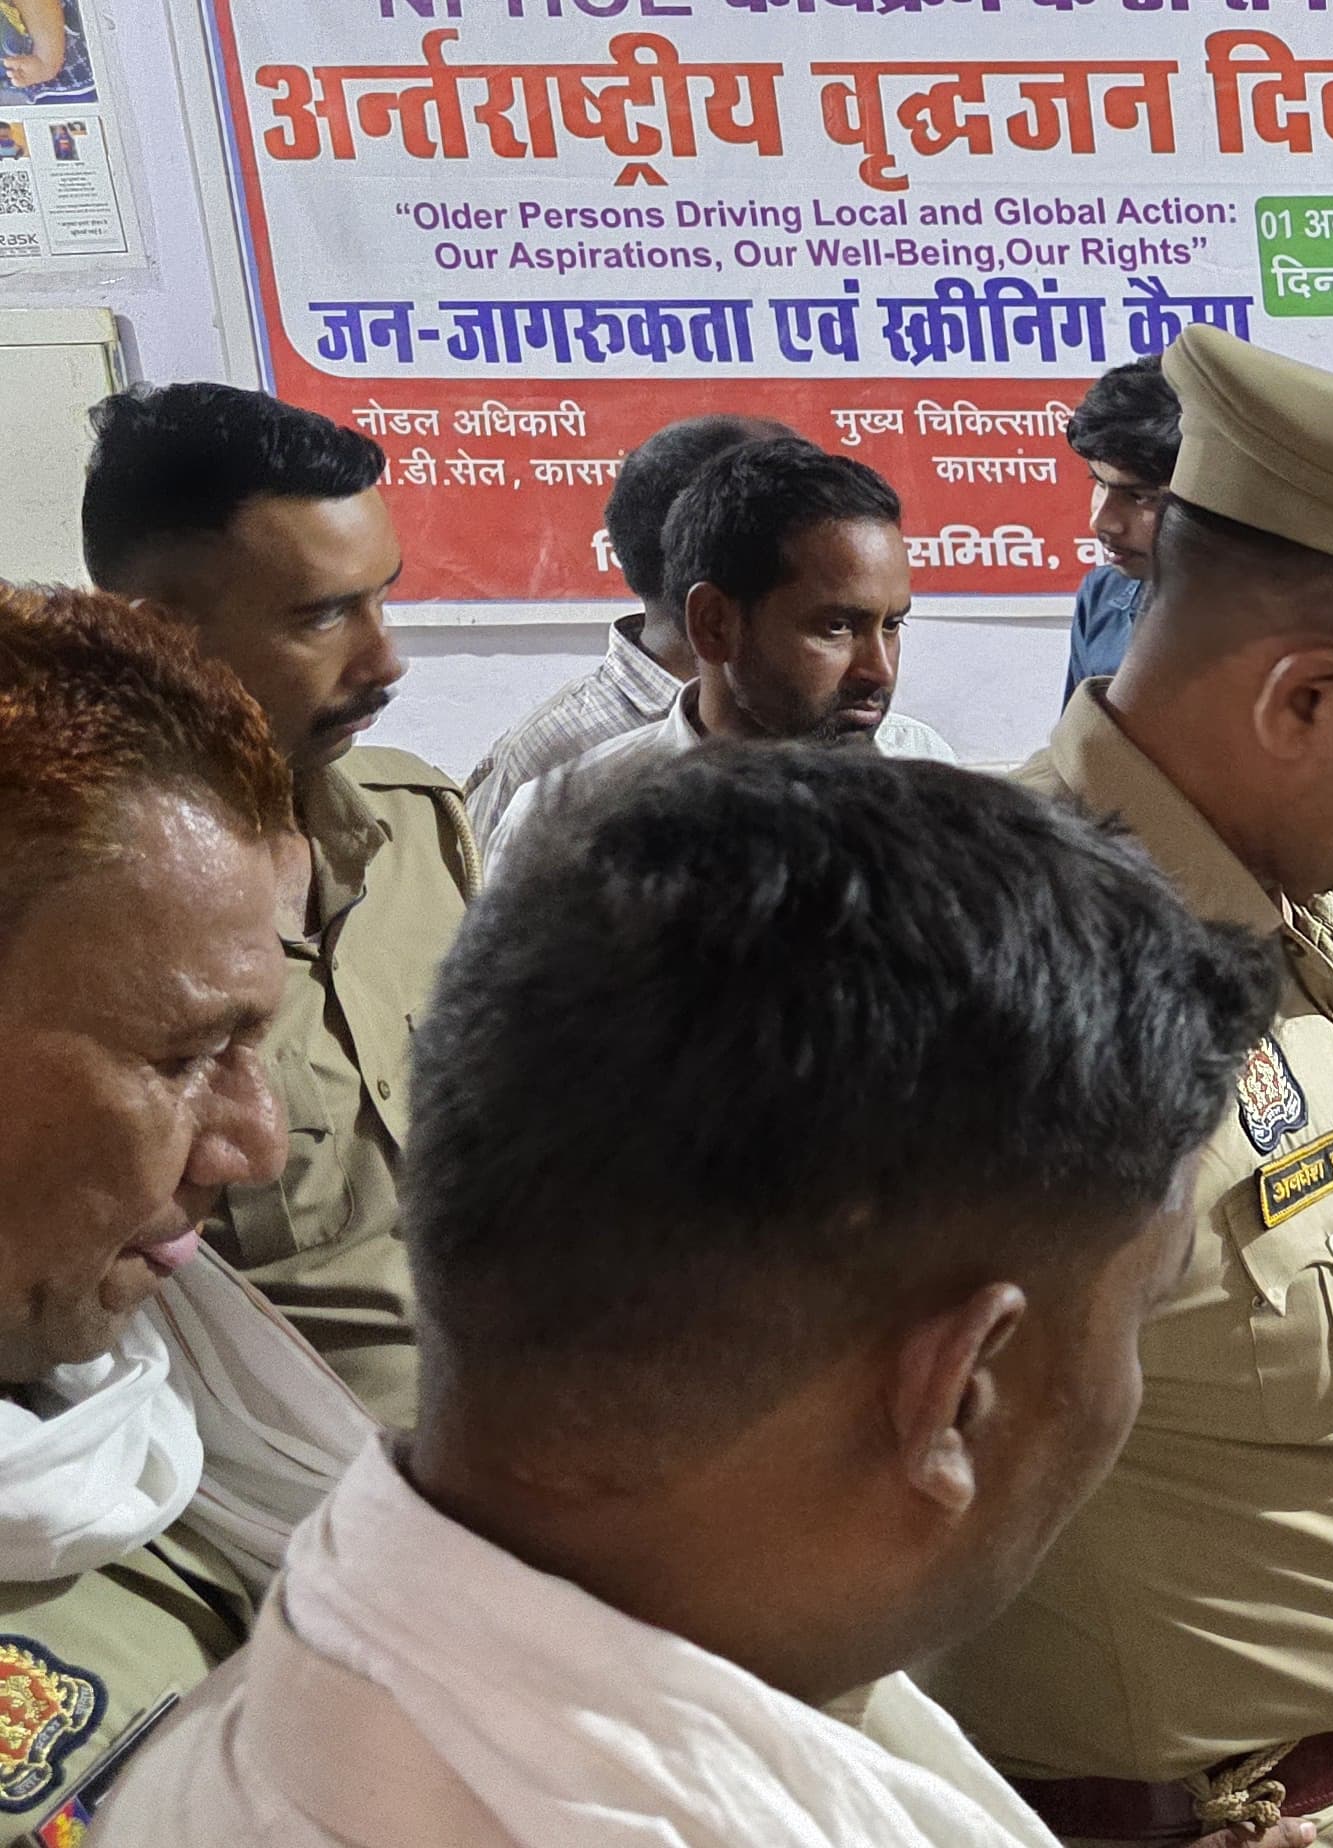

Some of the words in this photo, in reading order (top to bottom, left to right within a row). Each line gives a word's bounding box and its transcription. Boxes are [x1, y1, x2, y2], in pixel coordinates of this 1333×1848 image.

[811, 60, 1178, 192] वृद्धजन
[394, 202, 507, 231] “Older
[519, 202, 665, 230] Persons
[676, 200, 803, 235] Driving
[813, 199, 907, 226] Local
[920, 198, 983, 225] and
[993, 197, 1107, 227] Global
[1117, 197, 1238, 226] Action:
[1260, 209, 1293, 240] 01
[433, 242, 499, 271] Our
[509, 241, 723, 276] Aspirations,
[733, 240, 796, 268] Our
[1080, 237, 1208, 272] Rights”
[308, 299, 754, 365] जन-जागरूकता
[768, 279, 861, 363] एवं
[876, 276, 1107, 367] स्क्रीनिंग
[352, 398, 440, 436] नोडल
[452, 400, 587, 438] अधिकारी
[830, 409, 904, 447] मुख्य
[931, 448, 1057, 485] कासगंज
[902, 523, 1061, 570] समिति,
